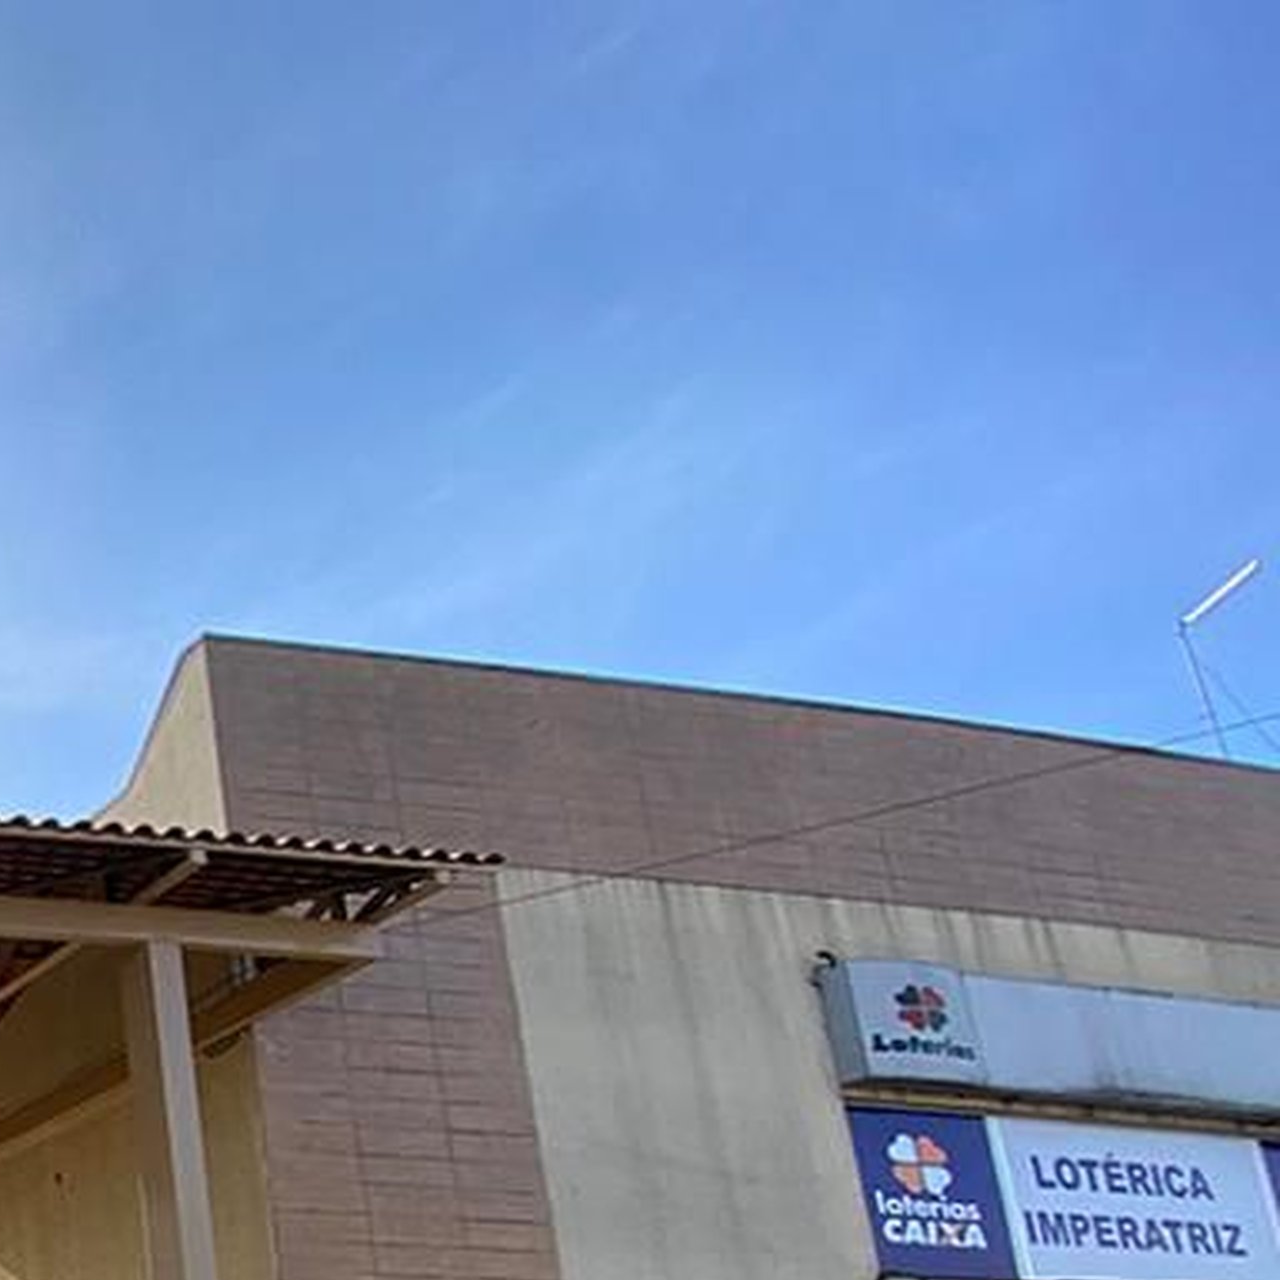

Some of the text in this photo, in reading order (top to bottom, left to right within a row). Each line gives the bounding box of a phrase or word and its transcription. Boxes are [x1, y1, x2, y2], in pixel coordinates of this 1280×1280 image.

[1030, 1152, 1216, 1201] LOTÉRICA
[875, 1190, 981, 1221] loterias
[883, 1219, 987, 1249] CAIXA
[1025, 1210, 1248, 1257] IMPERATRIZ
